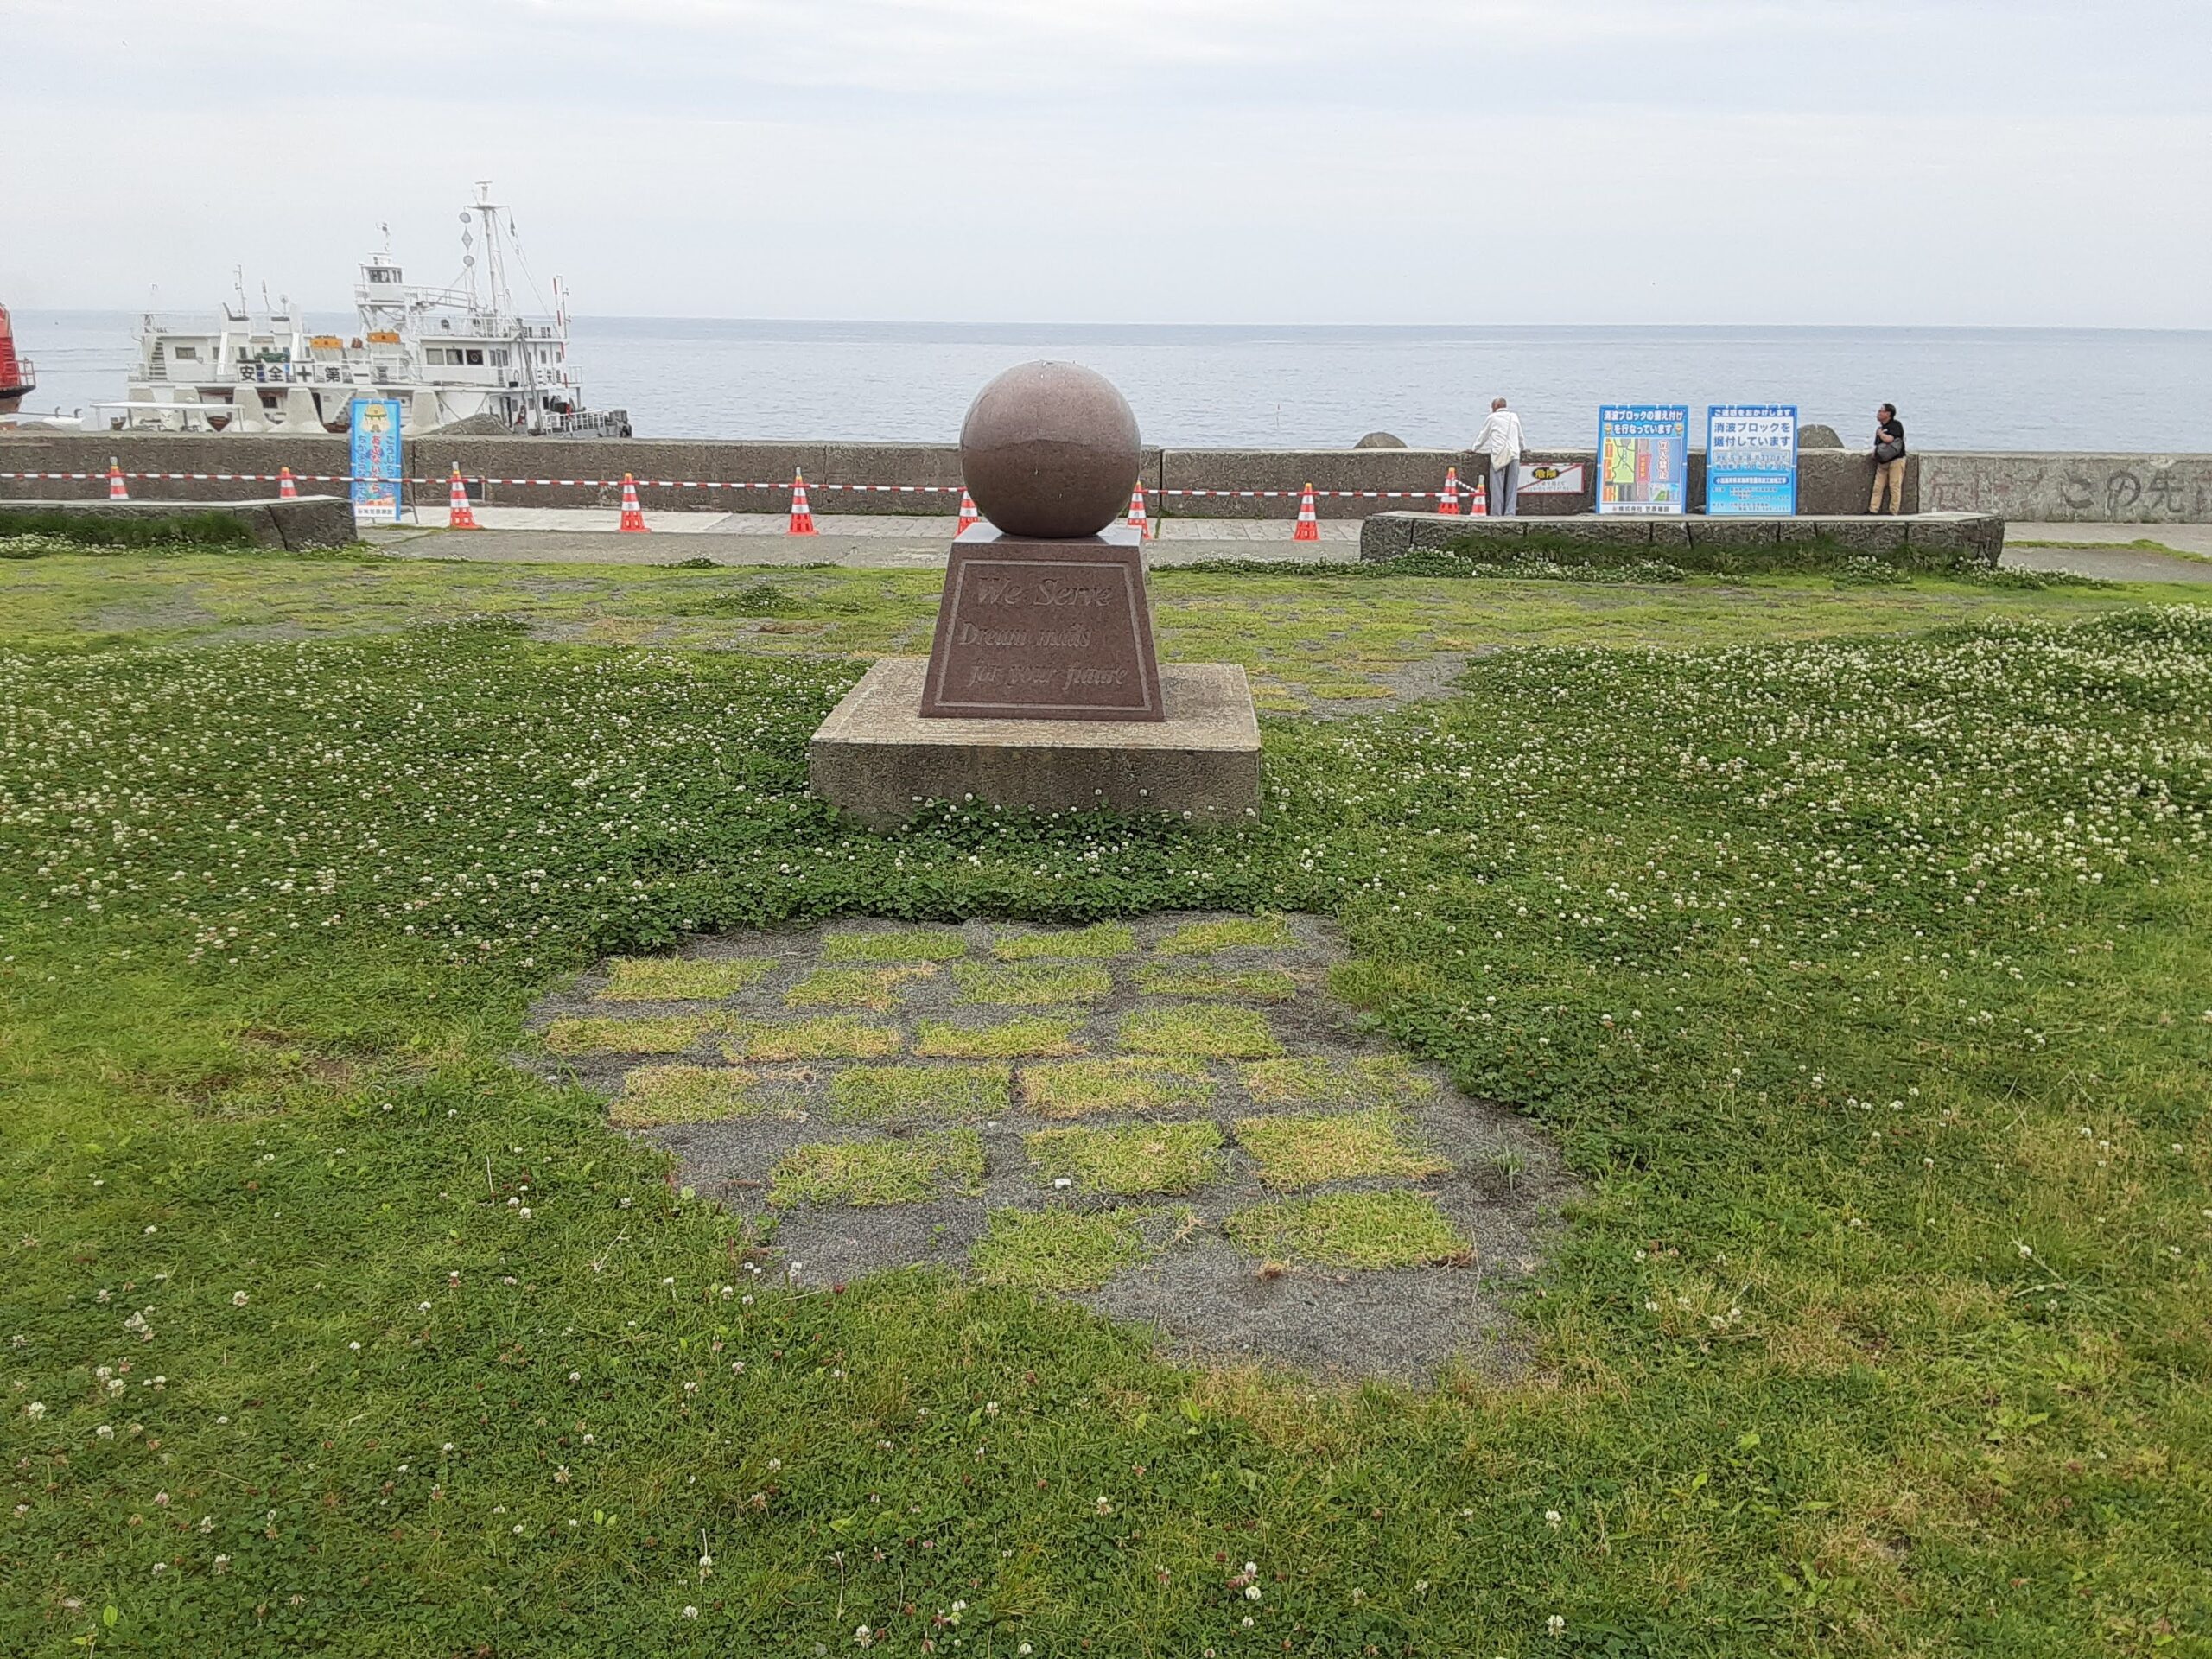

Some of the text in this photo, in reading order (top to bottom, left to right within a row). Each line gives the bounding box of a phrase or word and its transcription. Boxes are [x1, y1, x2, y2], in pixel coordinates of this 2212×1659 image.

[1614, 423, 1673, 435] を行なっています
[1714, 422, 1790, 432] 消波ブロックを
[1714, 436, 1790, 447] 据付しています
[977, 576, 1113, 606] We Serve
